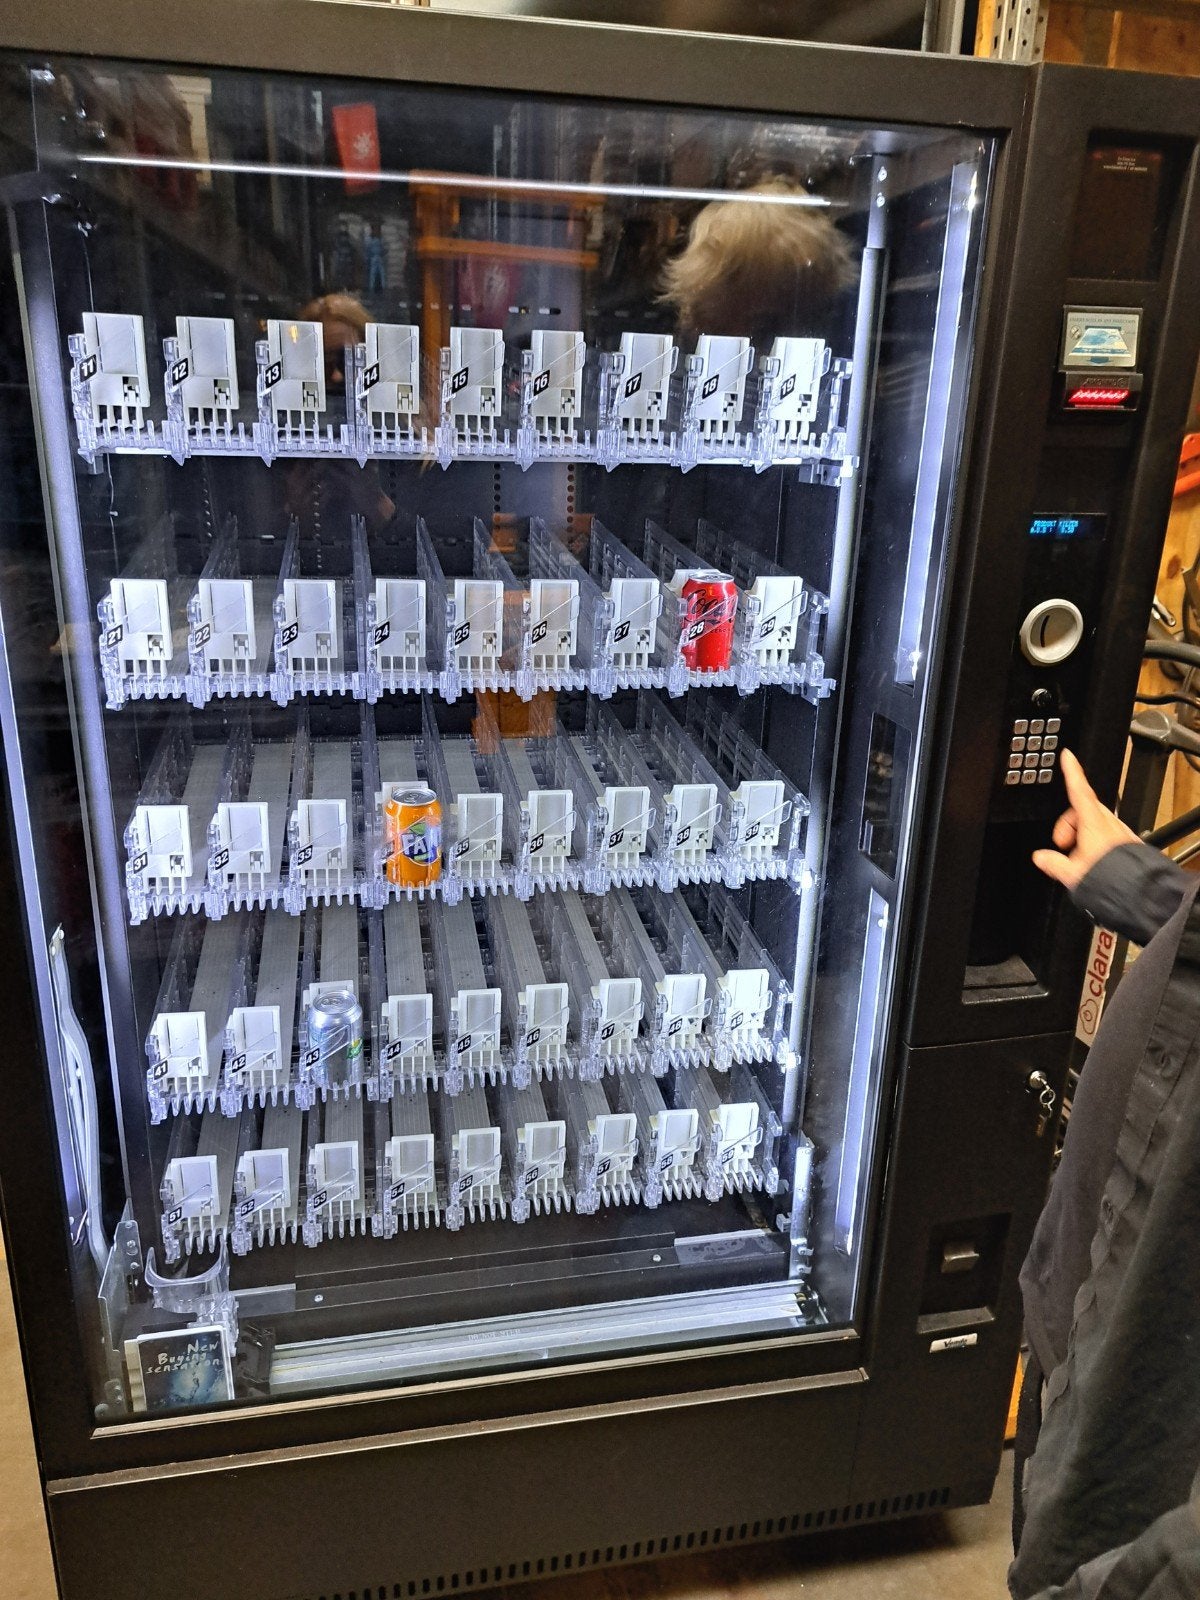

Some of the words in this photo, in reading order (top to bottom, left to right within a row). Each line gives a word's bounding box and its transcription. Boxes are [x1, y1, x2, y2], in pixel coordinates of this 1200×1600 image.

[81, 358, 95, 377] 11
[173, 362, 187, 381] 12
[266, 365, 280, 384] 13
[364, 367, 378, 385] 14
[453, 371, 467, 389] 15
[535, 374, 548, 392] 16
[626, 375, 640, 393] 17
[703, 377, 717, 395] 18
[781, 378, 795, 395] 19
[195, 626, 210, 645] 22
[283, 625, 298, 643] 23
[375, 624, 389, 642] 24
[455, 625, 469, 642] 25
[532, 623, 546, 641] 26
[615, 624, 629, 640] 27
[690, 621, 705, 638] 28
[761, 620, 775, 636] 29
[108, 628, 122, 646] 21
[610, 831, 624, 845] 37
[677, 830, 690, 843] 38
[745, 825, 759, 839] 39
[530, 836, 544, 852] 36
[133, 855, 148, 872] 31
[214, 852, 229, 868] 32
[298, 848, 312, 864] 33
[1088, 931, 1114, 998] clara
[731, 1013, 743, 1027] 49
[527, 1030, 540, 1044] 46
[602, 1025, 614, 1038] 47
[388, 1044, 400, 1058] 44
[458, 1037, 471, 1051] 45
[232, 1056, 246, 1073] 42
[307, 1050, 319, 1064] 43
[154, 1062, 168, 1078] 41
[459, 1177, 473, 1190] 55
[526, 1169, 538, 1183] 56
[391, 1184, 405, 1197] 54
[314, 1193, 327, 1206] 53
[168, 1210, 181, 1223] 51
[241, 1202, 254, 1216] 52
[187, 1339, 218, 1355] New
[146, 1358, 221, 1374] sensation
[158, 1351, 207, 1366] Buying
